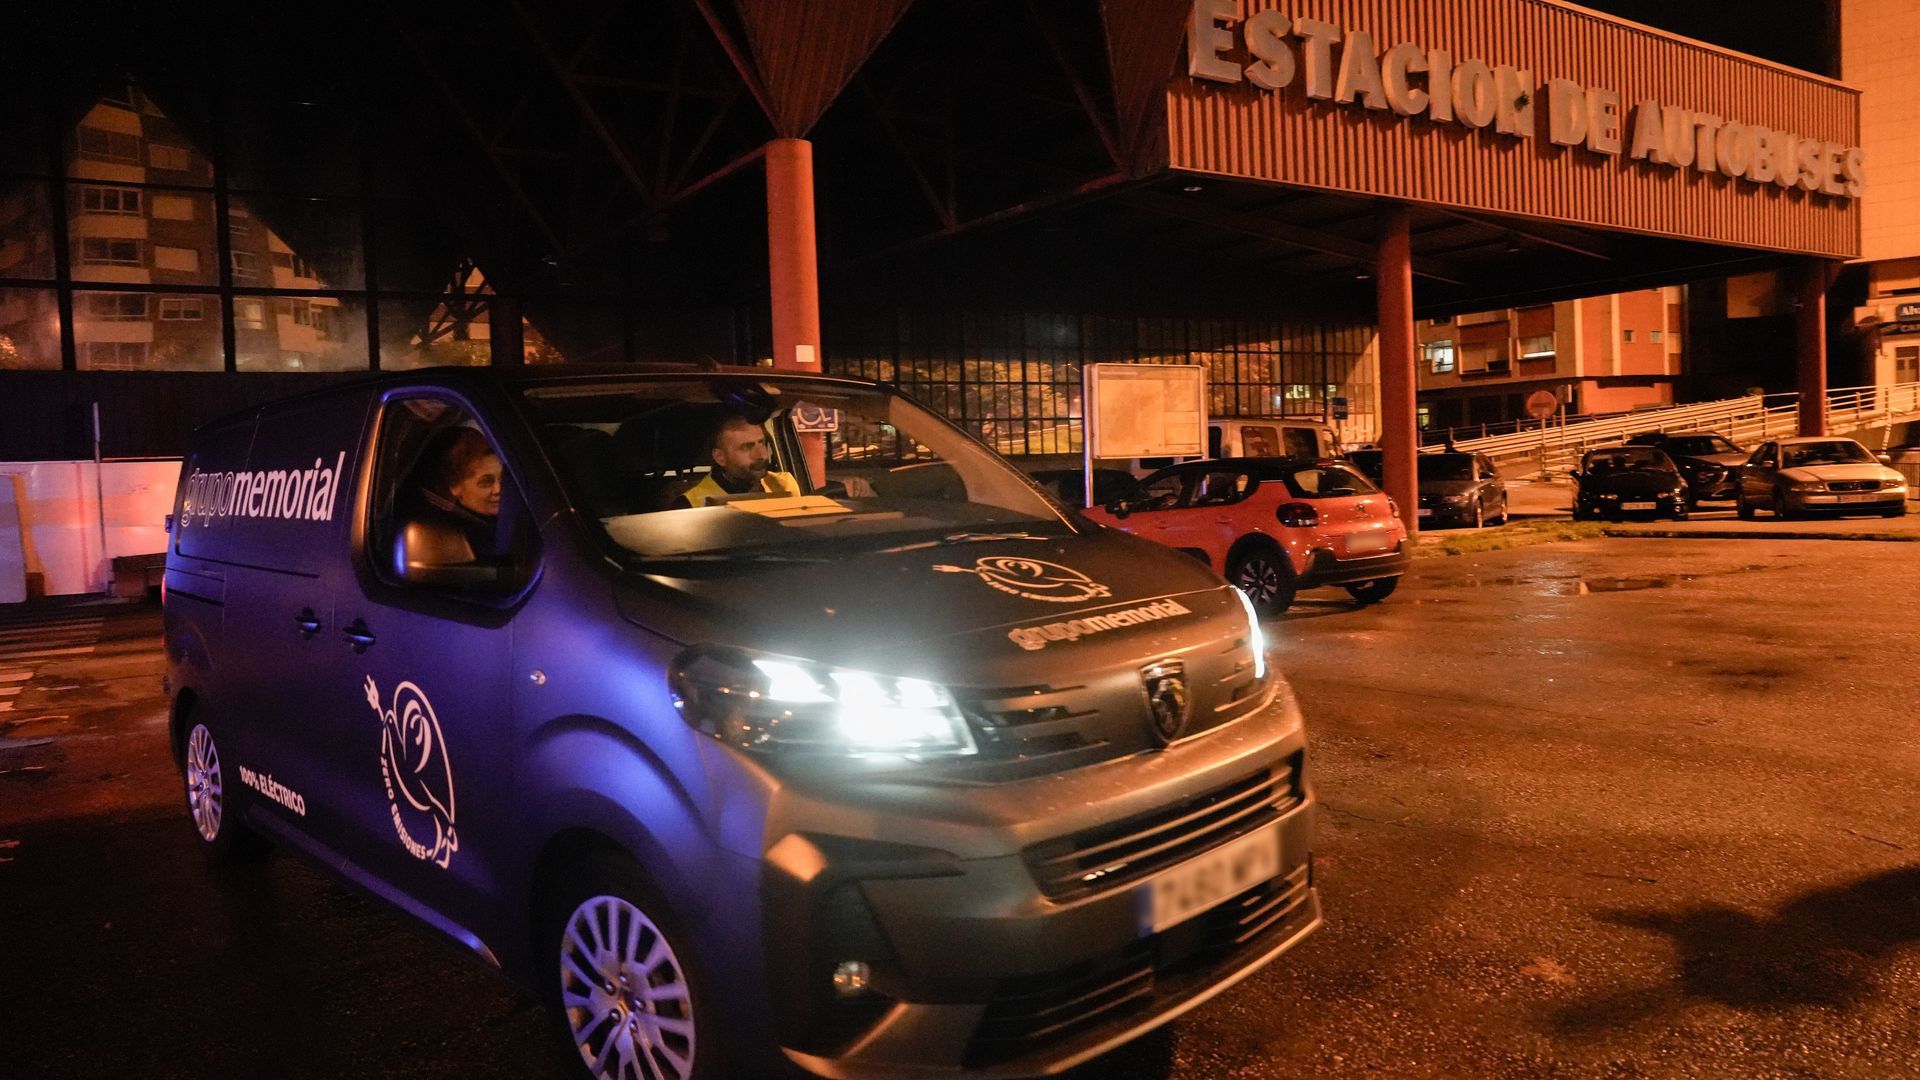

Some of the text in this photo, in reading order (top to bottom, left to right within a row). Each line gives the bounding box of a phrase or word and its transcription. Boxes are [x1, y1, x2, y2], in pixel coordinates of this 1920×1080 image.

[1188, 0, 1865, 198] ESTACION DE AUTOBUSES
[239, 765, 306, 817] 100% ELÉCTRICO
[391, 802, 427, 860] EMISIONES
